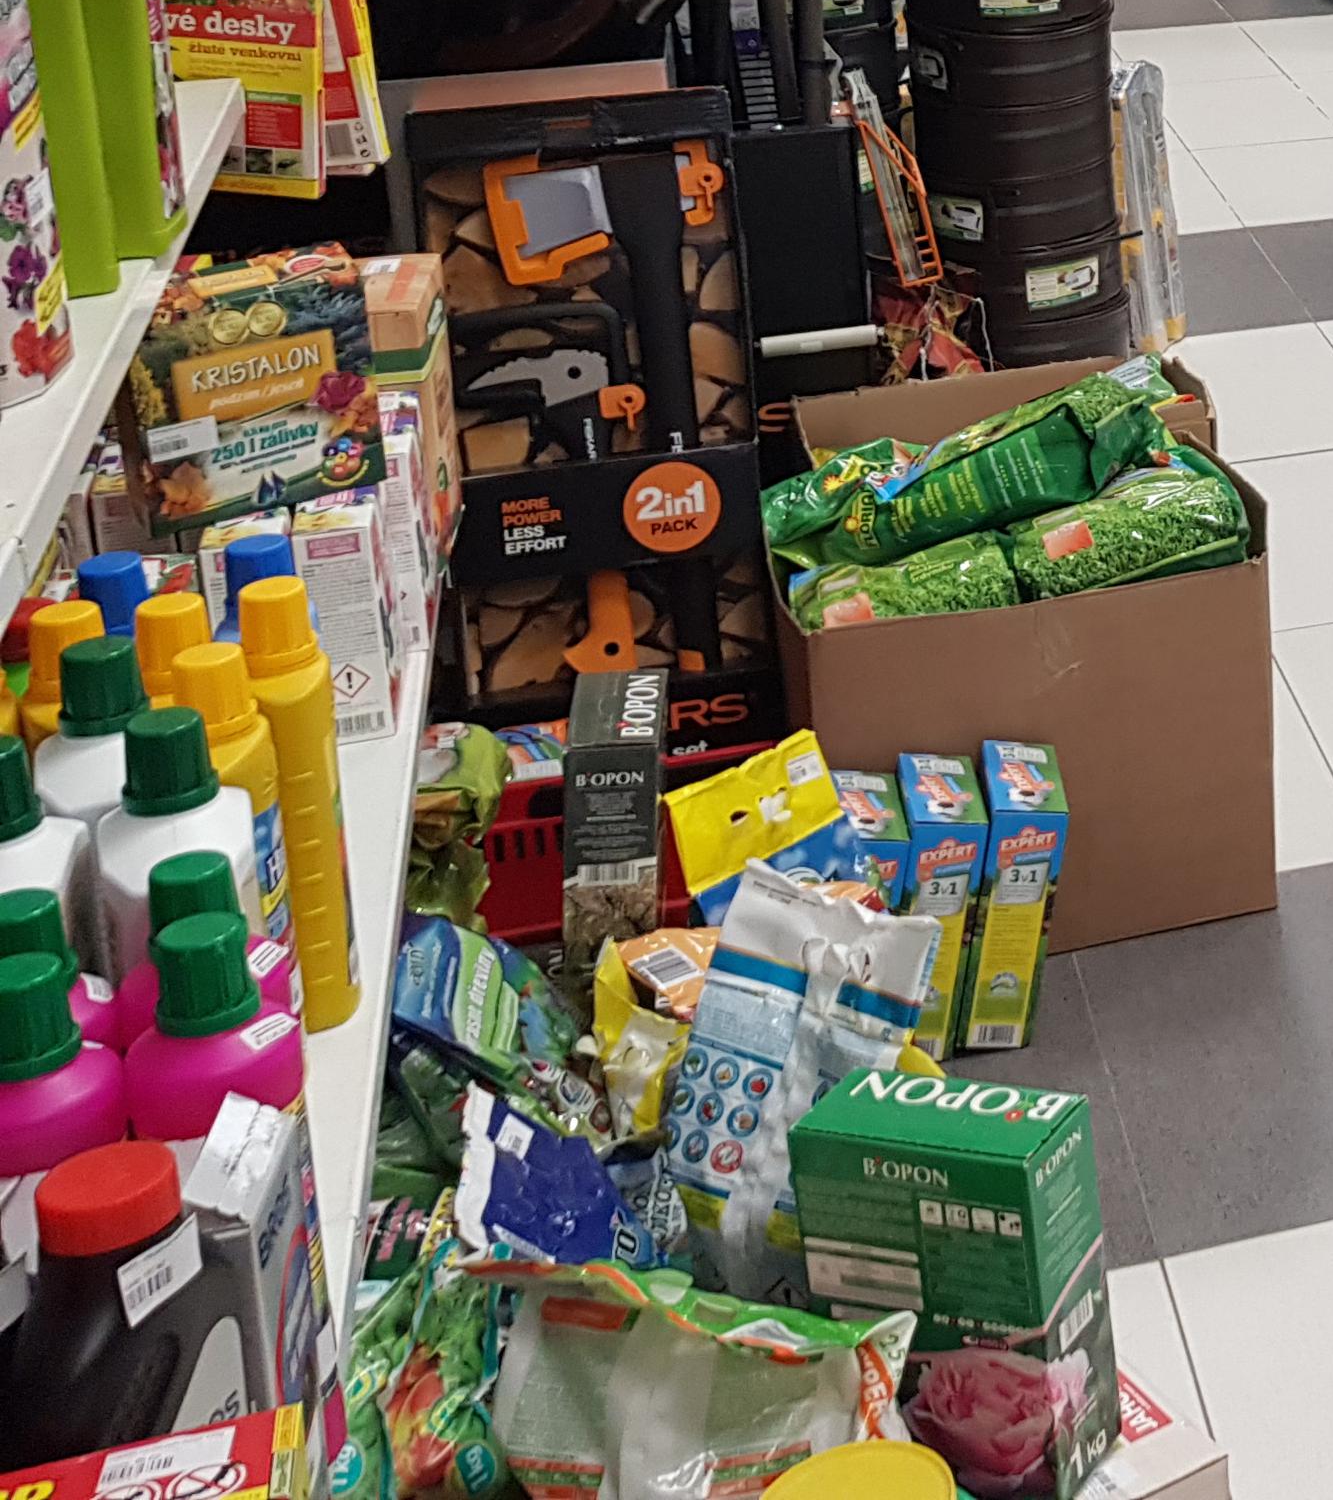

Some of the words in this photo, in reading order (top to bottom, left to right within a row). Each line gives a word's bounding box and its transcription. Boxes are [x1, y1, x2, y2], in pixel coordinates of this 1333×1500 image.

[164, 7, 197, 31] vé
[203, 10, 297, 45] desky
[190, 343, 322, 393] KRISTALON
[211, 440, 246, 465] 250
[501, 497, 550, 514] MORE
[635, 479, 707, 521] 2in1
[502, 508, 562, 528] POWER
[650, 517, 699, 536] PACK
[503, 524, 545, 542] LESS
[504, 535, 567, 556] EFFORT
[1000, 830, 1057, 853] EXPERT
[919, 843, 977, 862] EXPERT
[1008, 868, 1039, 885] 3v1
[928, 881, 959, 897] 3v1
